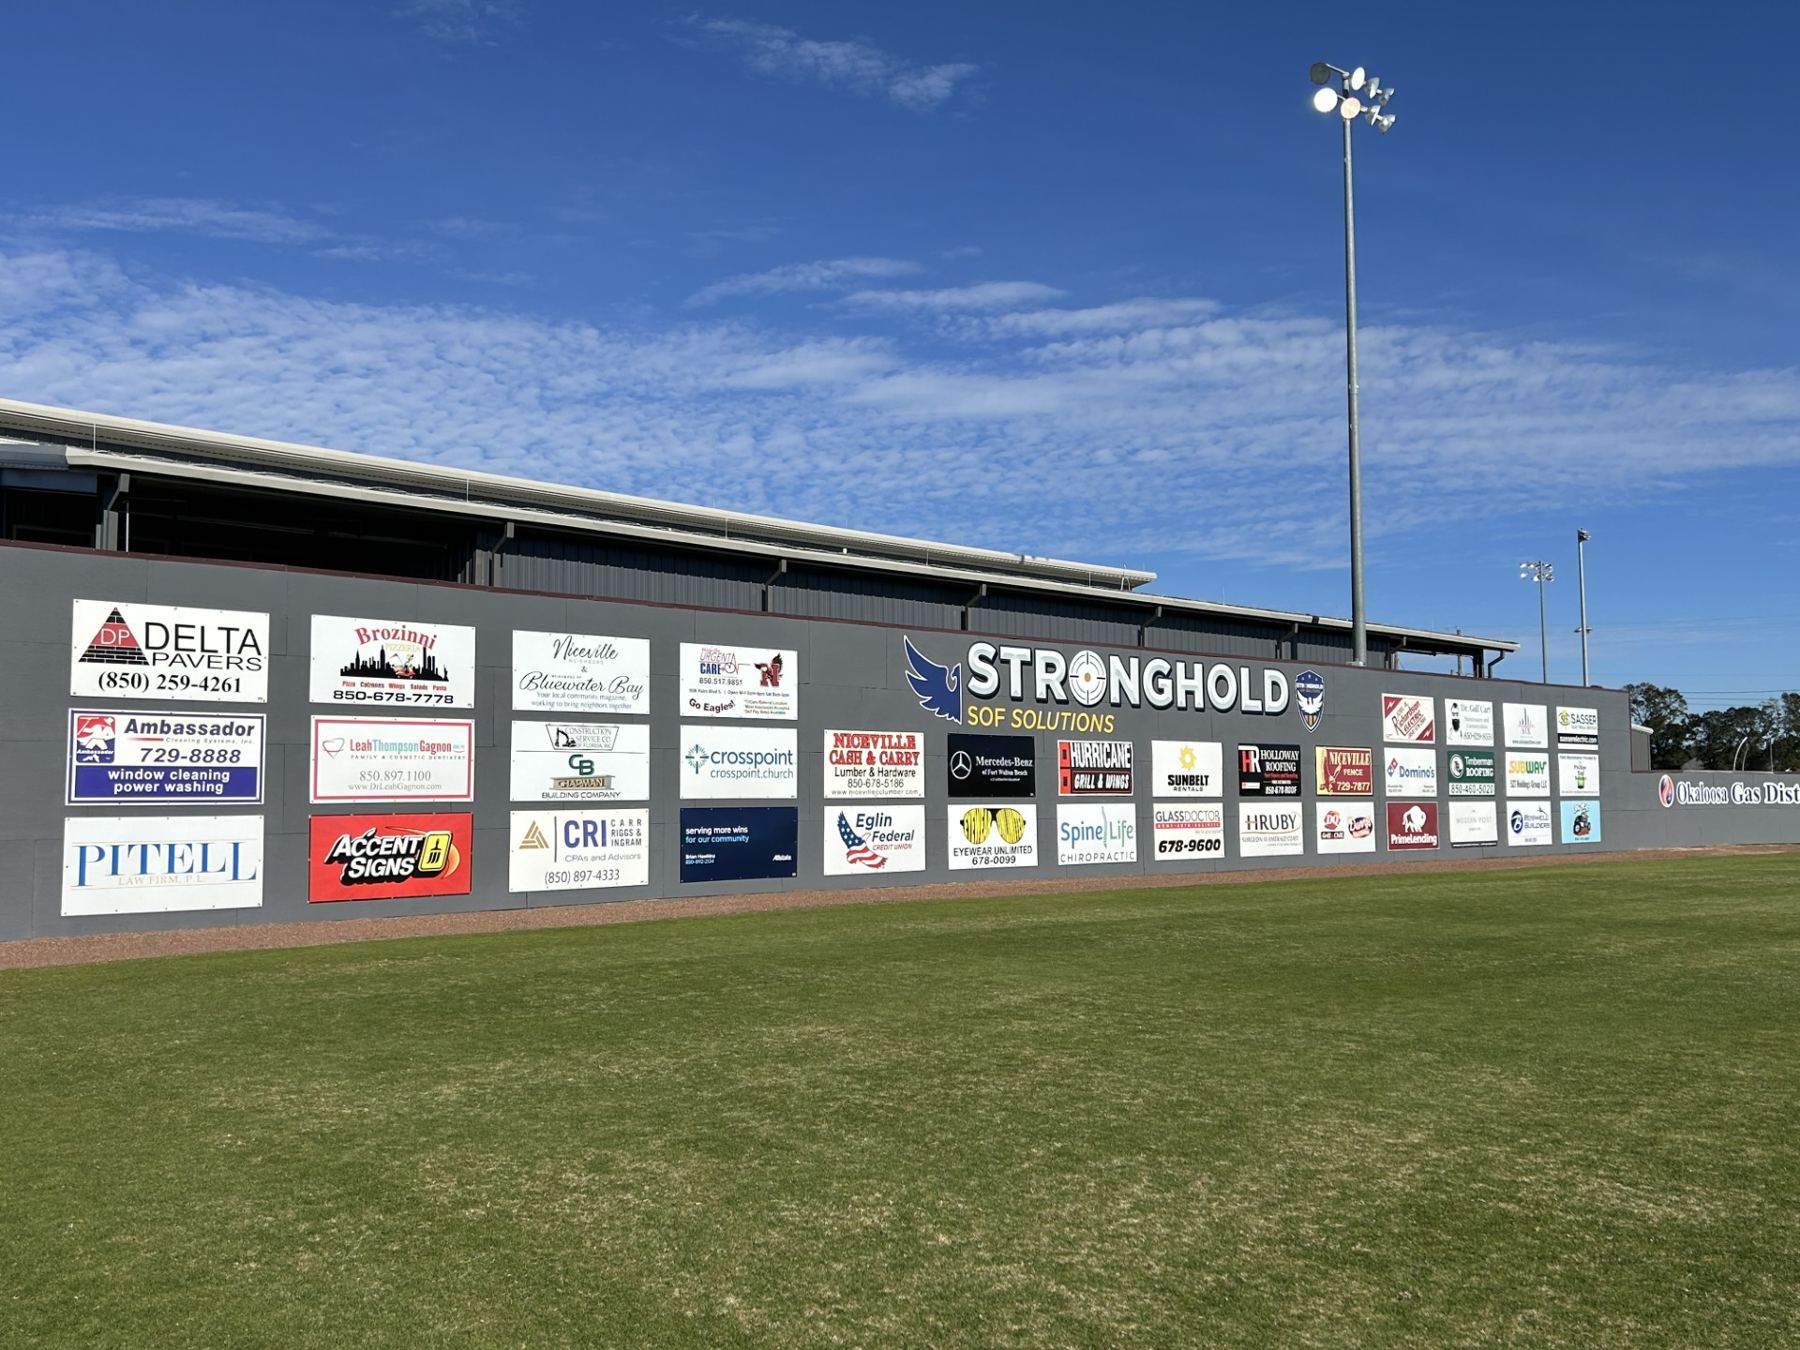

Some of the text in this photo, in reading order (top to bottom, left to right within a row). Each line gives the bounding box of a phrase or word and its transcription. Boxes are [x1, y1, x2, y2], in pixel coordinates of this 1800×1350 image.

[101, 628, 130, 645] DP
[145, 622, 262, 656] DELTA
[355, 625, 437, 650] Brozinni
[385, 643, 421, 652] PIZZERIA
[553, 635, 618, 660] Niceville
[152, 653, 262, 672] PAVERS
[700, 650, 732, 662] URGENT
[700, 663, 721, 675] CARE
[98, 672, 241, 693] (850) 259-4261
[967, 641, 1289, 716] STRONGHOLD
[519, 671, 644, 700] Bluewater Bay
[333, 690, 454, 704] 850-678-7778
[689, 698, 701, 709] Go
[704, 700, 735, 713] Eagles!
[966, 706, 1115, 734] SOF SOLUTIONS
[1571, 713, 1596, 724] SASSER
[124, 719, 255, 736] Ambassador
[833, 733, 916, 749] NICEVILLE
[140, 748, 241, 763] 729-8888
[711, 748, 793, 769] crosspoint
[829, 750, 920, 765] CASH & CARRY
[976, 756, 1033, 767] Mercedes-Benz
[1070, 742, 1131, 768] HURRICANE
[1238, 745, 1261, 772] HR
[1260, 750, 1300, 760] HOLLOWAY
[1329, 752, 1370, 765] NICEVILLE
[569, 754, 595, 776] CB
[1265, 762, 1296, 772] ROOFING
[1399, 765, 1435, 778] Domino's
[1509, 761, 1547, 774] SUBWAY
[108, 769, 230, 783] window cleaning
[359, 770, 431, 781] 850.897.1100
[710, 768, 794, 780] crosspoint.church
[834, 767, 916, 777] Lumber & Hardware
[1466, 768, 1493, 776] ROOFING
[558, 778, 605, 788] CHAPMAN
[847, 779, 904, 788] 850-678-5186
[1074, 774, 1095, 789] GRILL
[1106, 774, 1129, 789] WINGS
[1168, 775, 1209, 786] SUNBELT
[1337, 782, 1370, 791] 729-7877
[114, 782, 223, 794] power washing
[1676, 782, 1729, 804] Okaloosa
[1731, 782, 1761, 804] Gas
[610, 819, 642, 827] CARR
[856, 812, 892, 830] Eglin
[1245, 814, 1296, 830] HRUBY
[564, 820, 607, 848] CRI
[611, 828, 642, 837] RIGGS &
[685, 827, 712, 835] serving
[872, 830, 914, 842] Federal
[326, 829, 423, 862] ACCENT
[611, 838, 642, 846] INGRAM
[711, 835, 749, 843] community
[1391, 833, 1437, 846] PrimeLending
[953, 845, 1032, 856] EYEWEAR UNLIMITED
[1158, 839, 1221, 853] 678-9600
[565, 854, 588, 862] CPAs
[608, 853, 641, 861] Advisors
[972, 856, 1016, 865] 678-0099
[1061, 852, 1134, 863] CHIROPRACTIC
[71, 842, 257, 887] PITELL
[341, 857, 414, 879] SIGNS
[118, 876, 145, 886] LAW
[545, 869, 620, 884] (850) 897-4333
